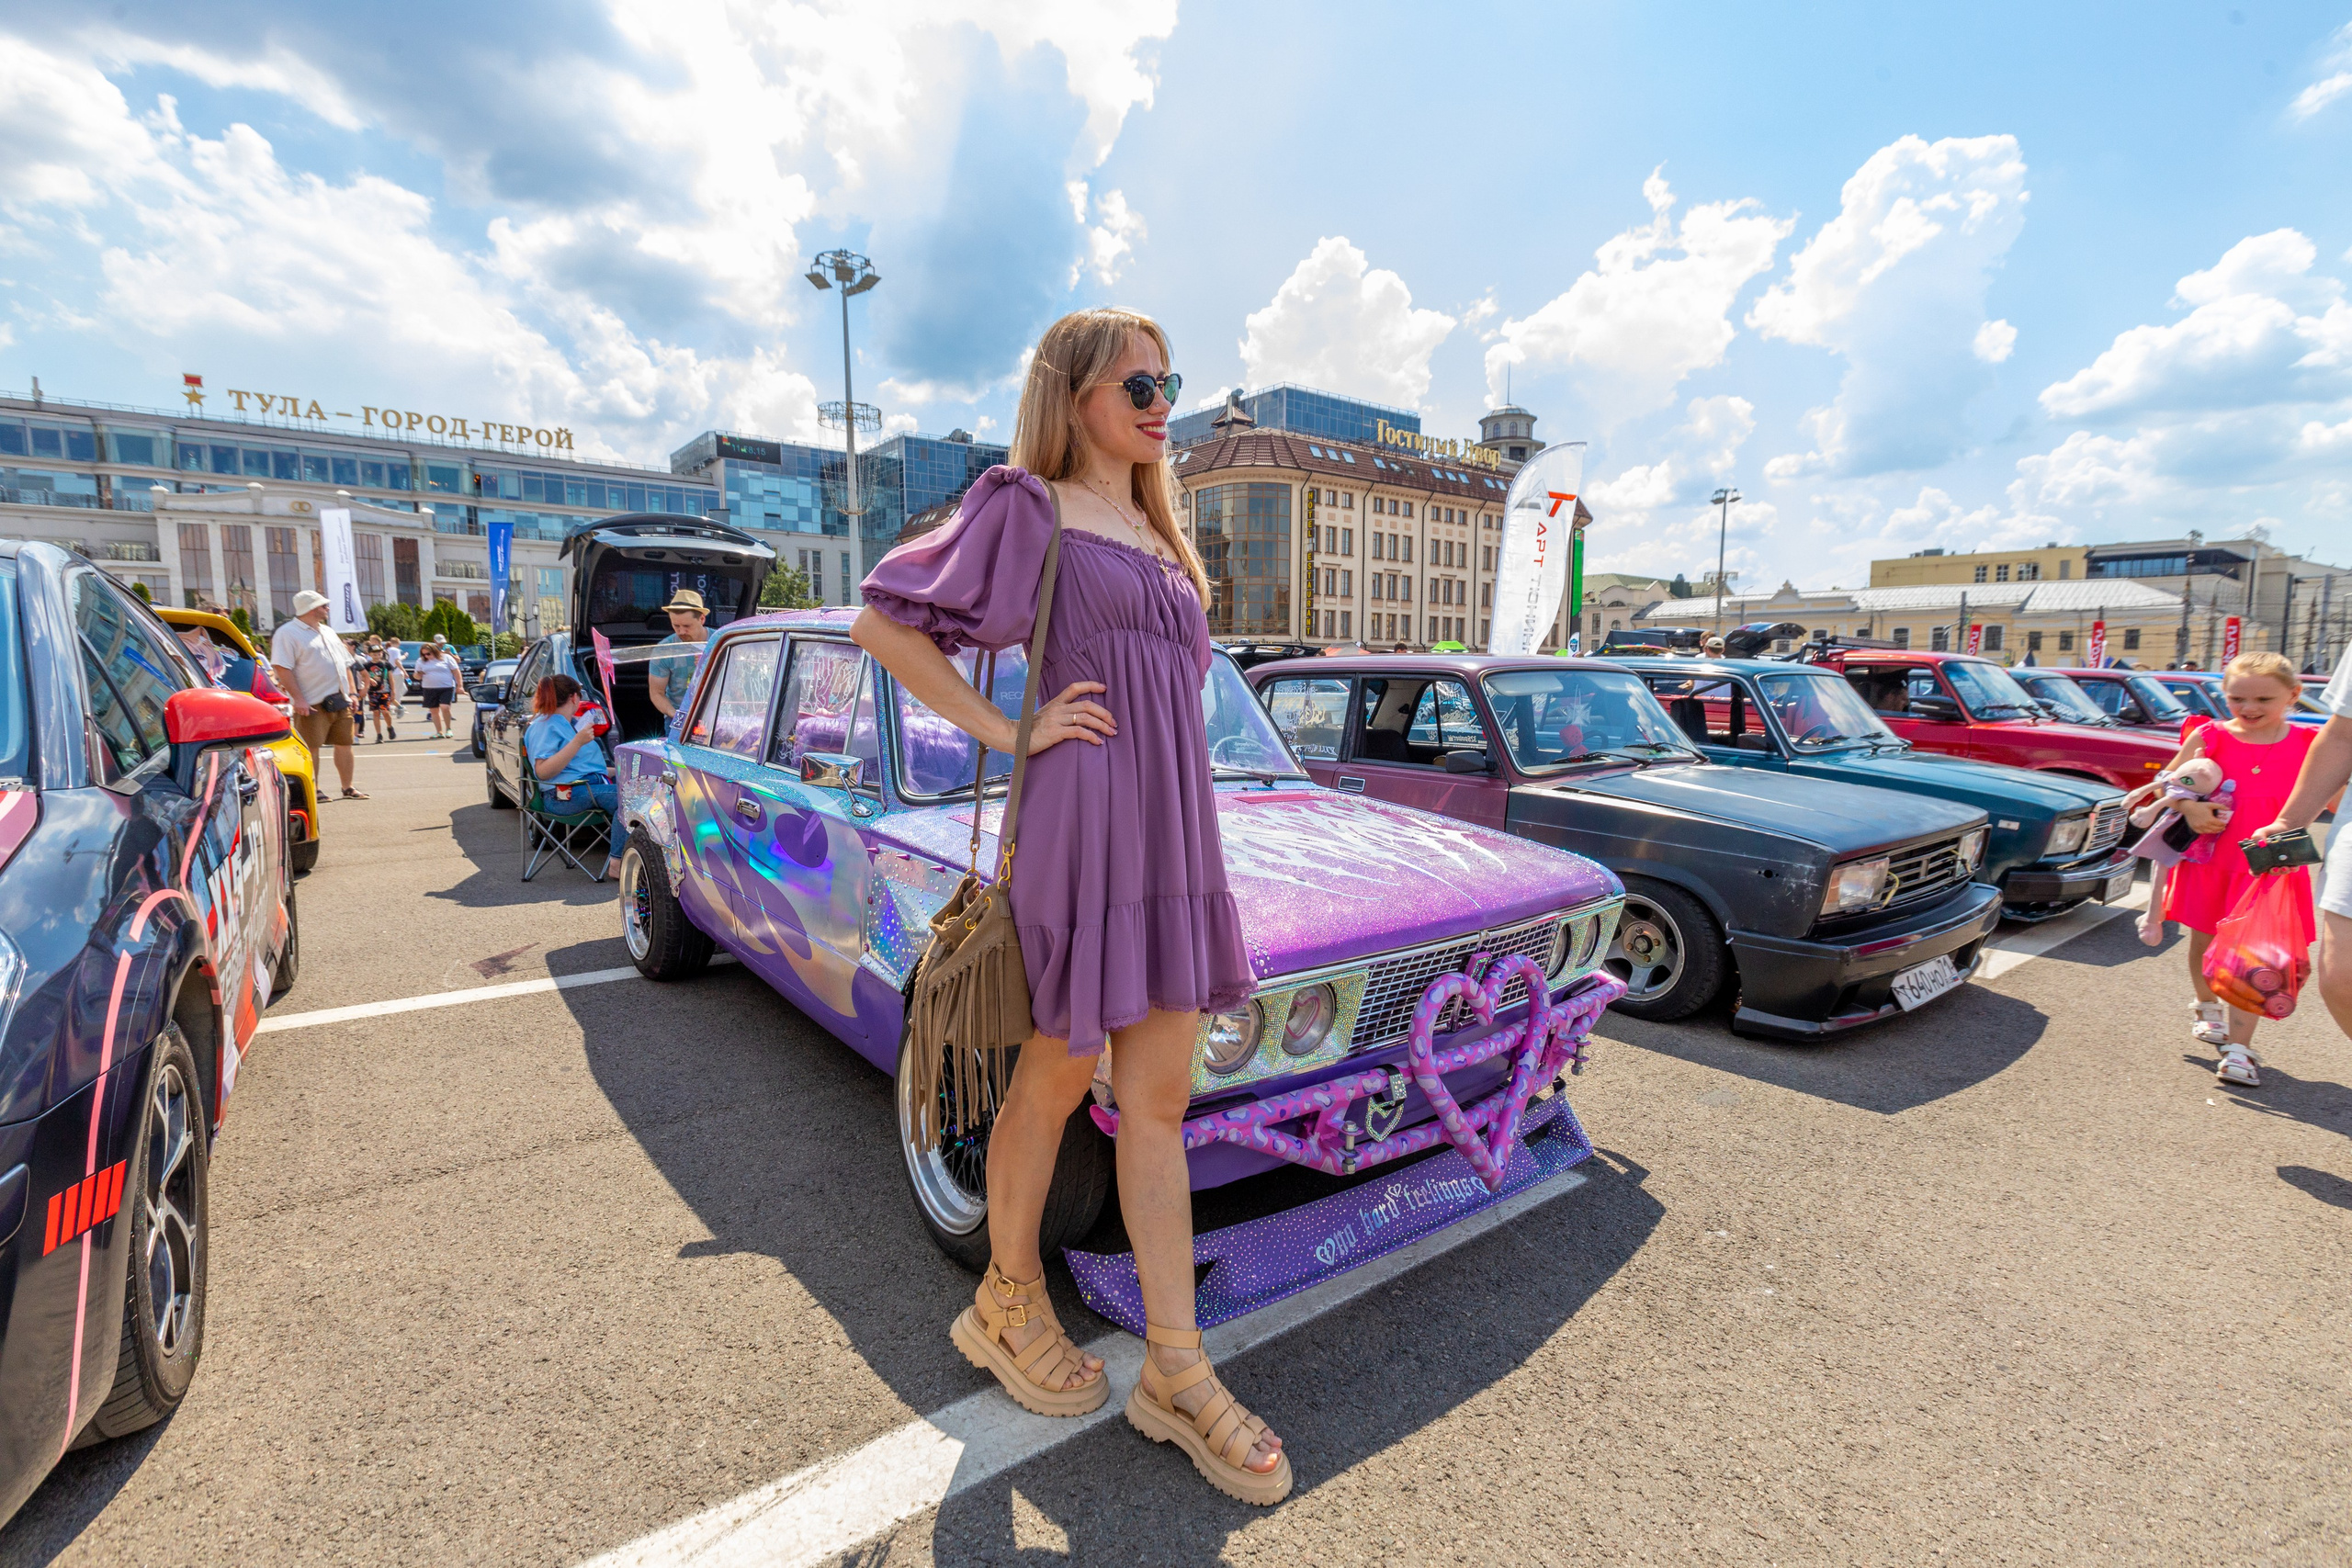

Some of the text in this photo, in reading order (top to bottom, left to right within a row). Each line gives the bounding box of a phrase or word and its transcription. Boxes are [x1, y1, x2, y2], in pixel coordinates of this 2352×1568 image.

[227, 389, 328, 421] ТУЛА
[361, 405, 575, 450] ГОРОД-ГЕРОЙ
[1376, 418, 1501, 472] Гостиный Двор
[2089, 628, 2104, 669] uto.ru
[1358, 1191, 1401, 1236] hard
[1403, 1176, 1474, 1211] feelings
